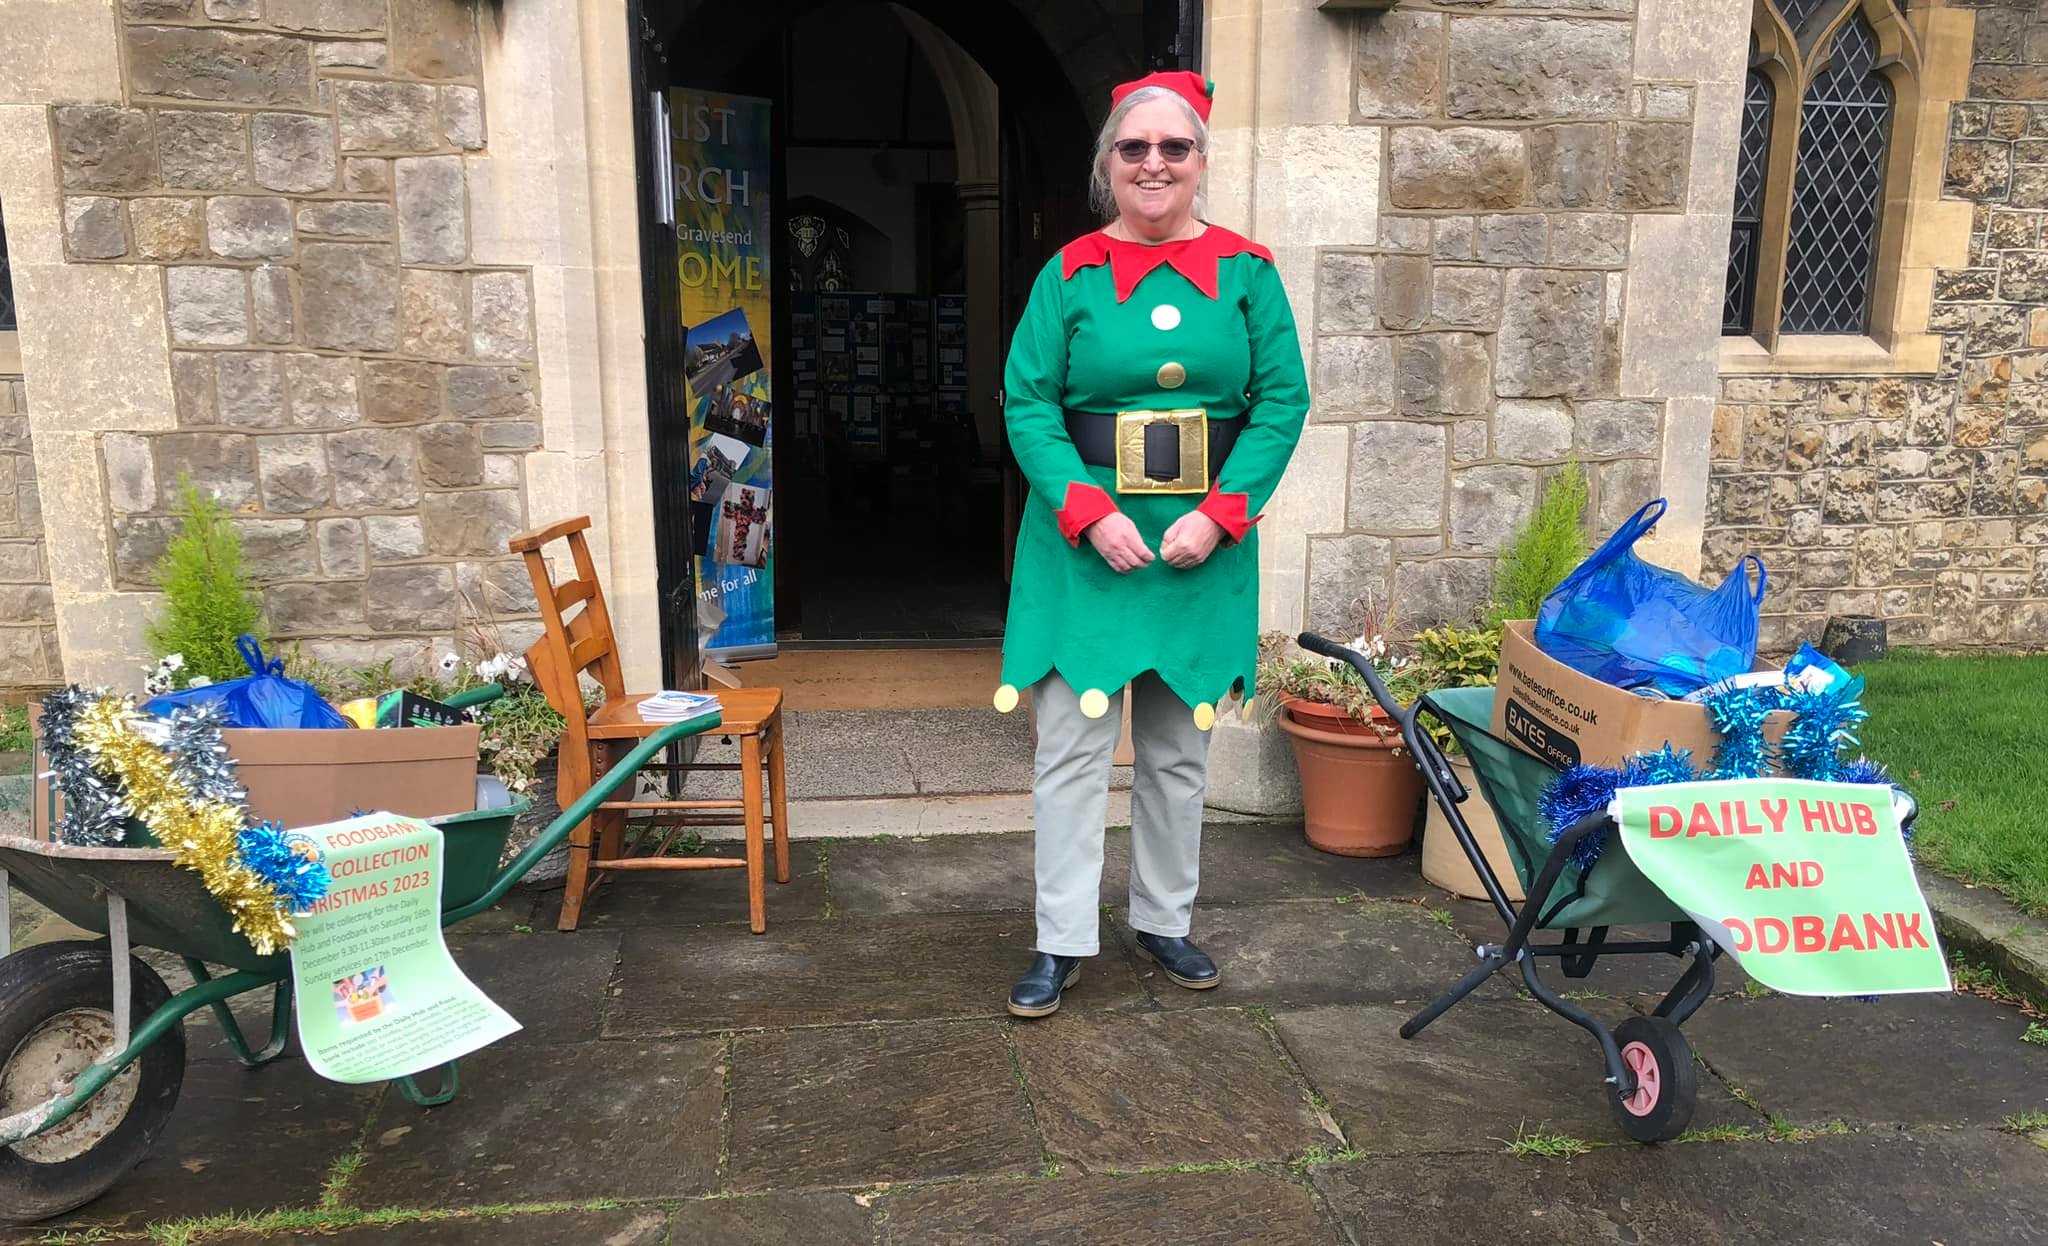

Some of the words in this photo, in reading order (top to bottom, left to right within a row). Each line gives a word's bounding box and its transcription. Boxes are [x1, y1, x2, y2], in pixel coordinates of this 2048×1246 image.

[671, 103, 737, 145] IST
[676, 223, 752, 246] Gravesend
[678, 251, 762, 290] OME
[721, 578, 739, 594] for
[743, 568, 757, 585] all
[1508, 662, 1598, 725] www.batesoffice.co.uk
[1509, 707, 1546, 749] BATES
[1649, 798, 1788, 839] DAILY
[1799, 799, 1878, 836] HUB
[331, 843, 430, 879] COLLECTION
[1744, 861, 1824, 889] AND
[306, 880, 389, 916] HRISTMAS
[393, 870, 430, 894] 2023
[317, 938, 331, 947] and
[332, 925, 368, 944] Foodbank
[369, 923, 380, 931] on
[381, 913, 413, 930] Saturday
[325, 920, 336, 931] be
[337, 909, 373, 927] collecting
[374, 906, 385, 916] for
[386, 902, 399, 913] the
[400, 897, 419, 910] Daily
[302, 952, 340, 971] December
[392, 929, 407, 940] and
[304, 970, 332, 986] Sunday
[333, 960, 362, 976] services
[363, 956, 374, 966] on
